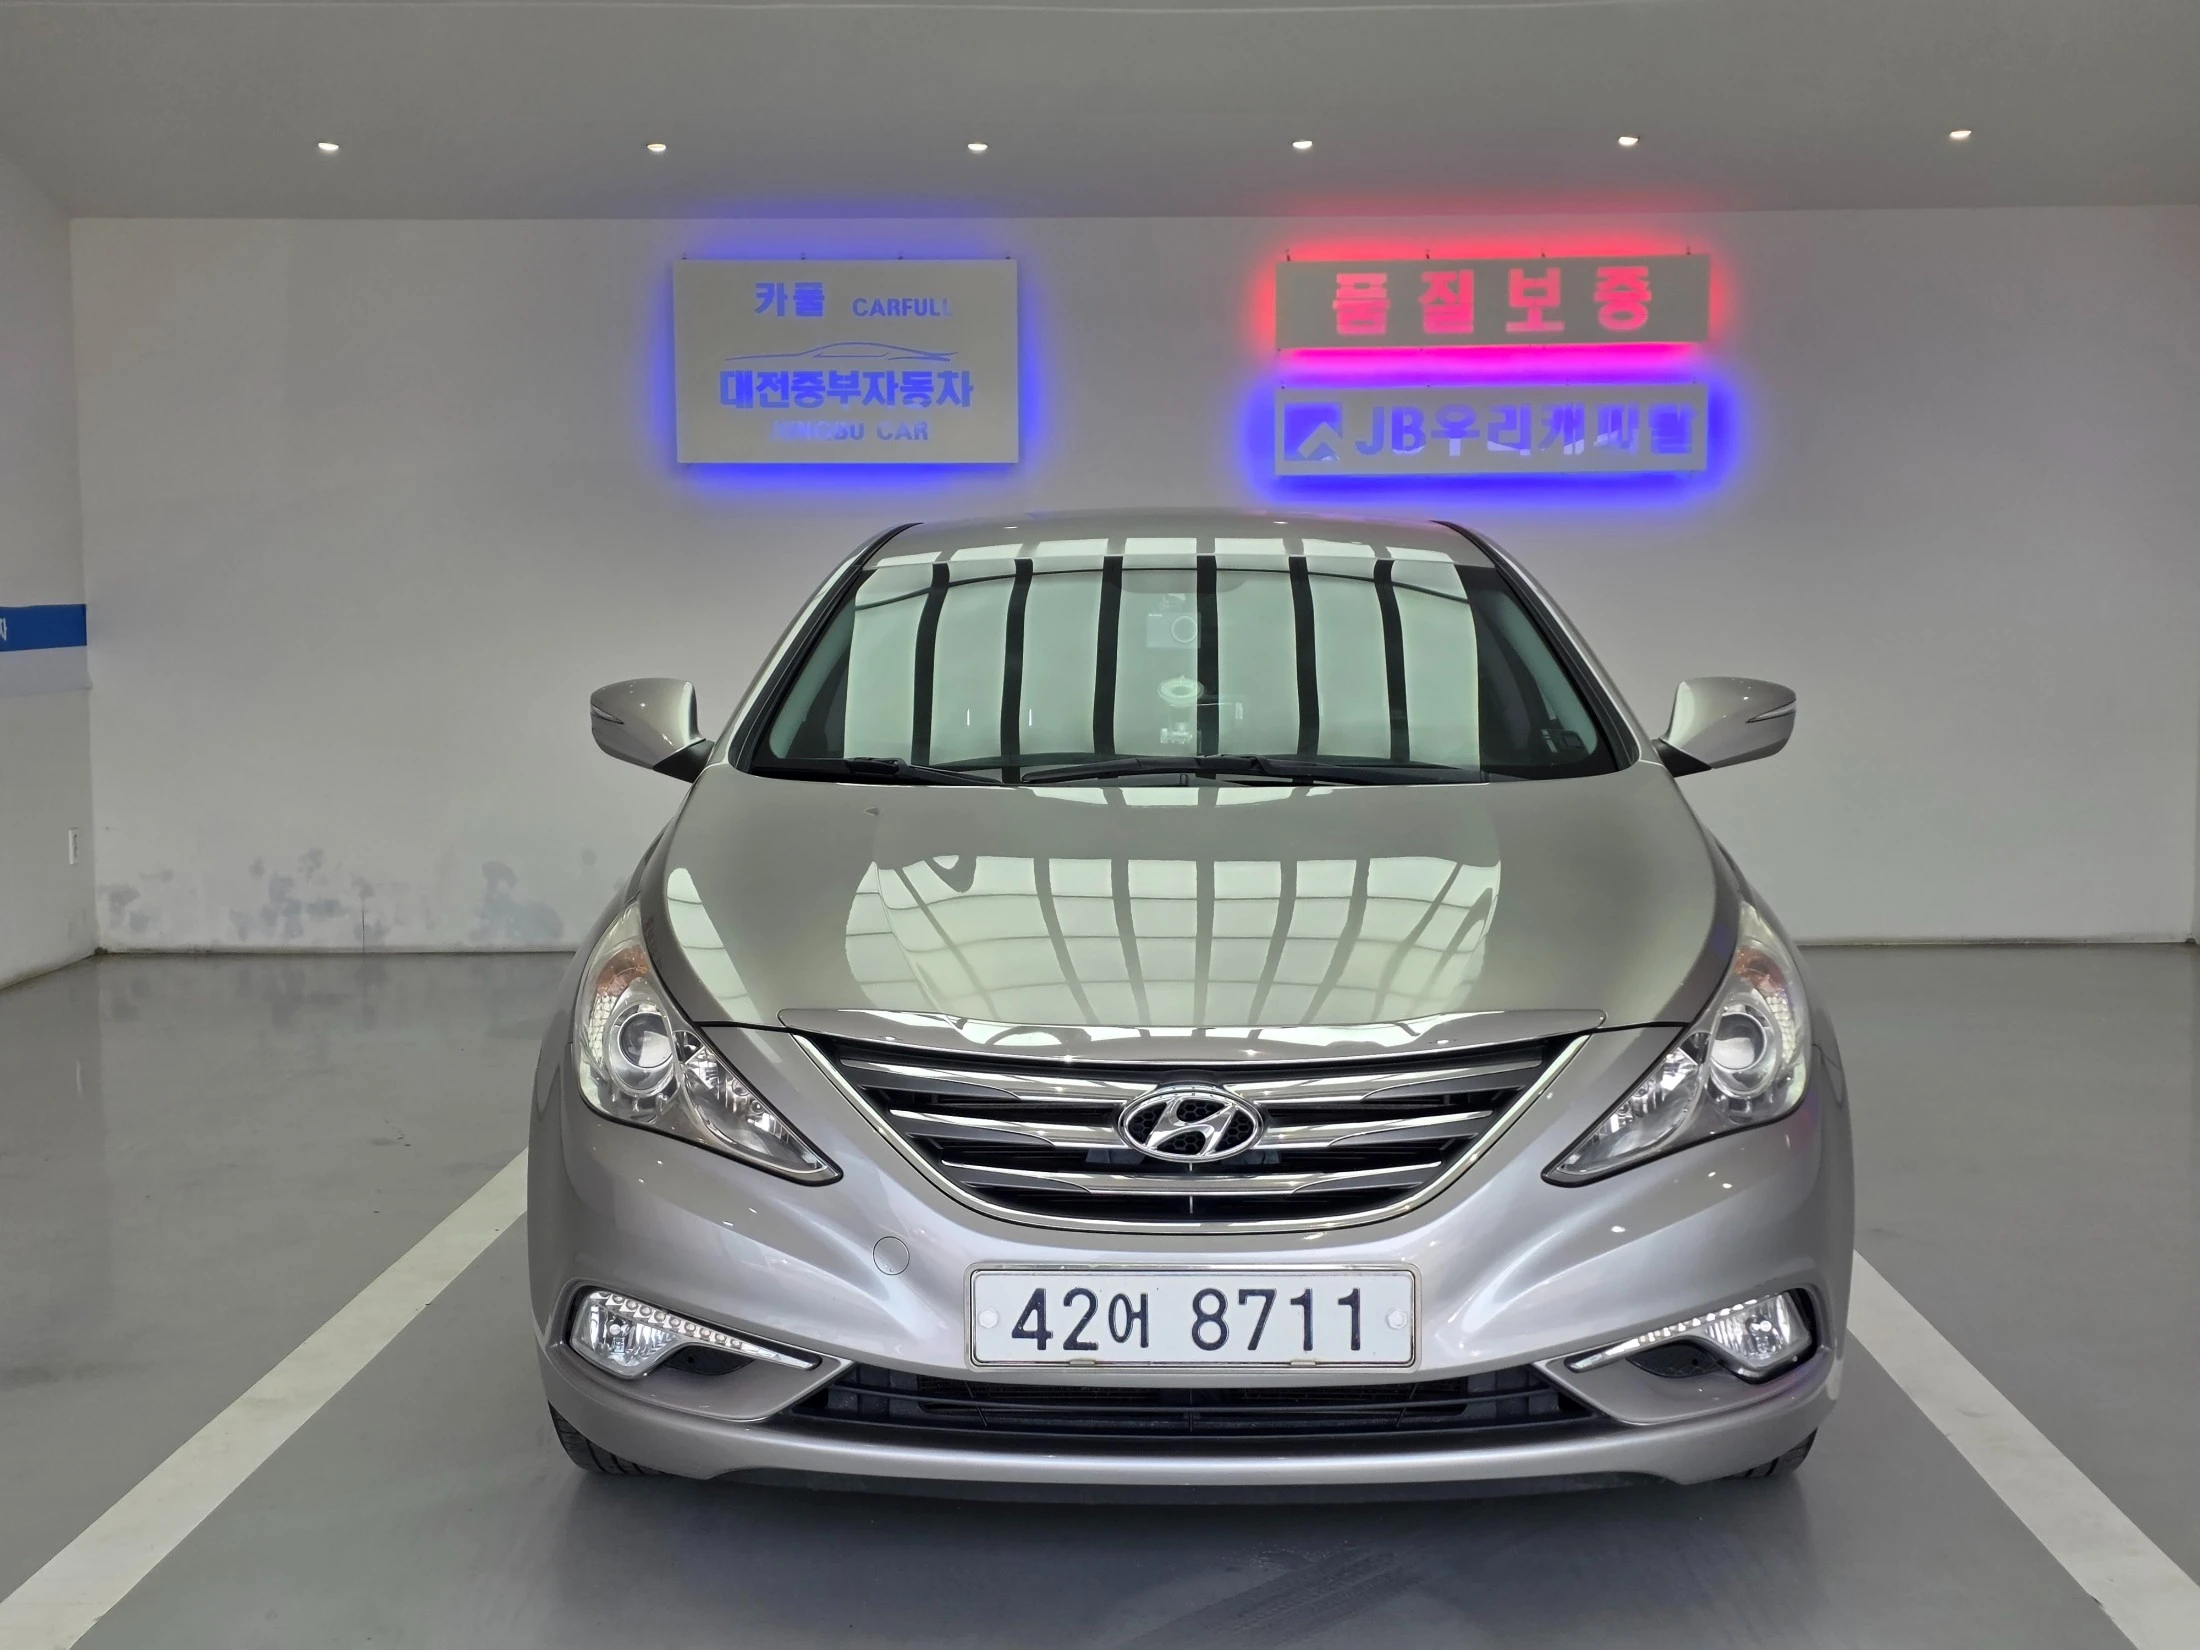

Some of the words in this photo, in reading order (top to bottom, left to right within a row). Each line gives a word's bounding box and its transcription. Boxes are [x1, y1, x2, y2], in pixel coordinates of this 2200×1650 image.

[852, 297, 953, 318] CARFULL
[719, 370, 974, 409] 대전중부자동차
[876, 421, 929, 441] CAR
[1011, 1287, 1150, 1351] 42어
[1190, 1287, 1362, 1351] 8711
